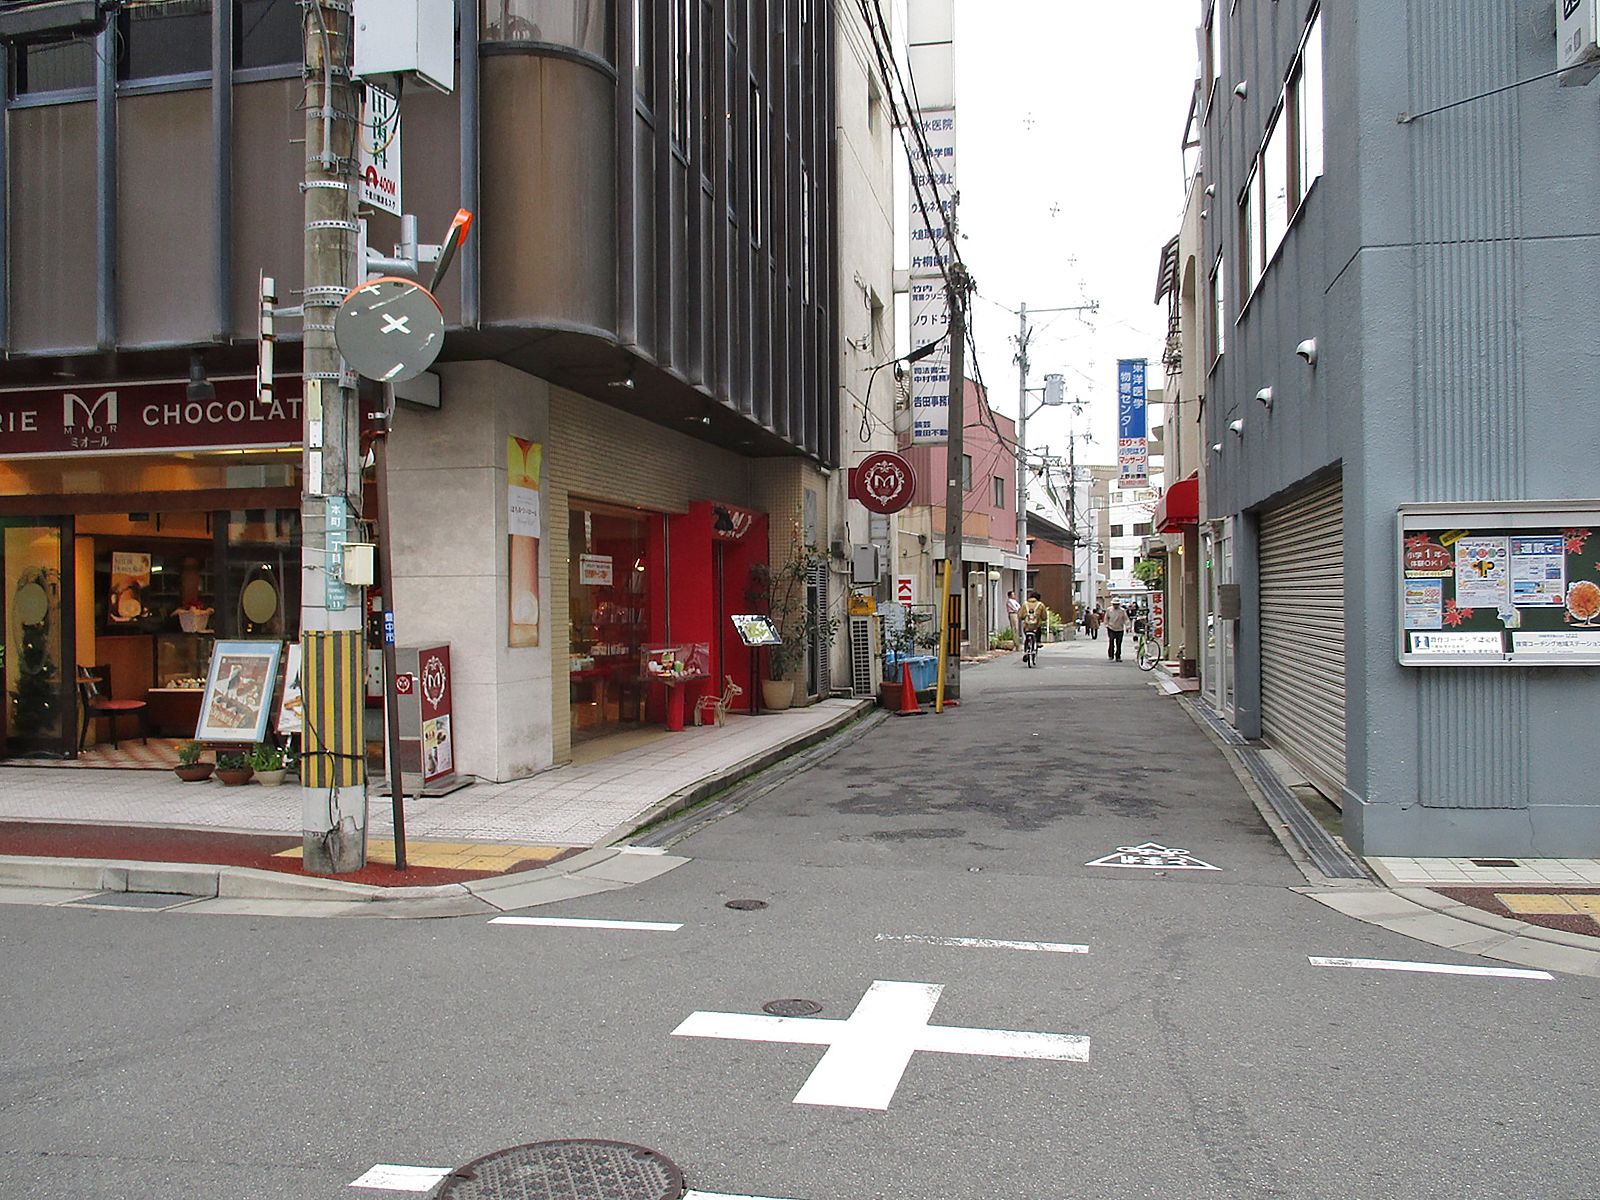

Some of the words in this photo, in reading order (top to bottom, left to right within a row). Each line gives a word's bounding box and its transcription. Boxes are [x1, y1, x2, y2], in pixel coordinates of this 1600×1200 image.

[64, 425, 117, 434] MIOR
[71, 435, 110, 448] ミオール
[1119, 456, 1146, 464] マッサージ
